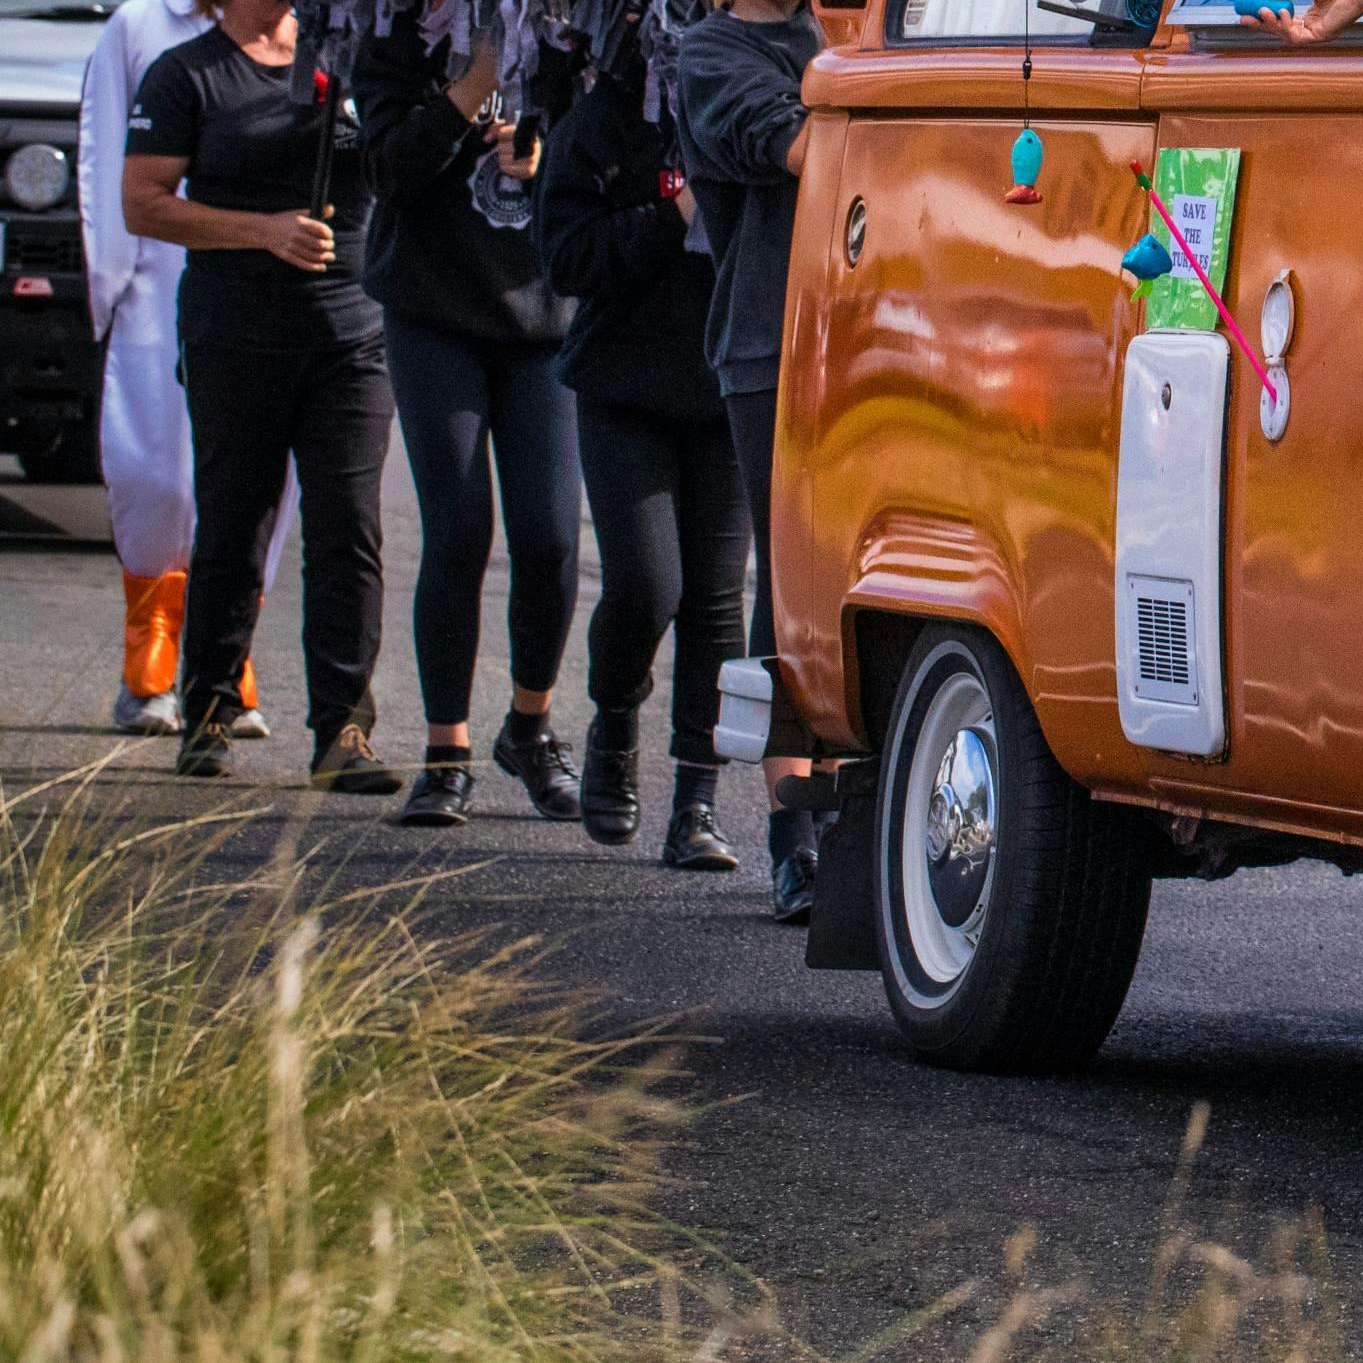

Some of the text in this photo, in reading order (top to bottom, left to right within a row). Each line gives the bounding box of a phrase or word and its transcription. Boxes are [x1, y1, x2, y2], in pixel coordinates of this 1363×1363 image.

[1183, 203, 1206, 220] SAVE
[1184, 228, 1201, 244] THE
[1172, 252, 1209, 270] TURLES
